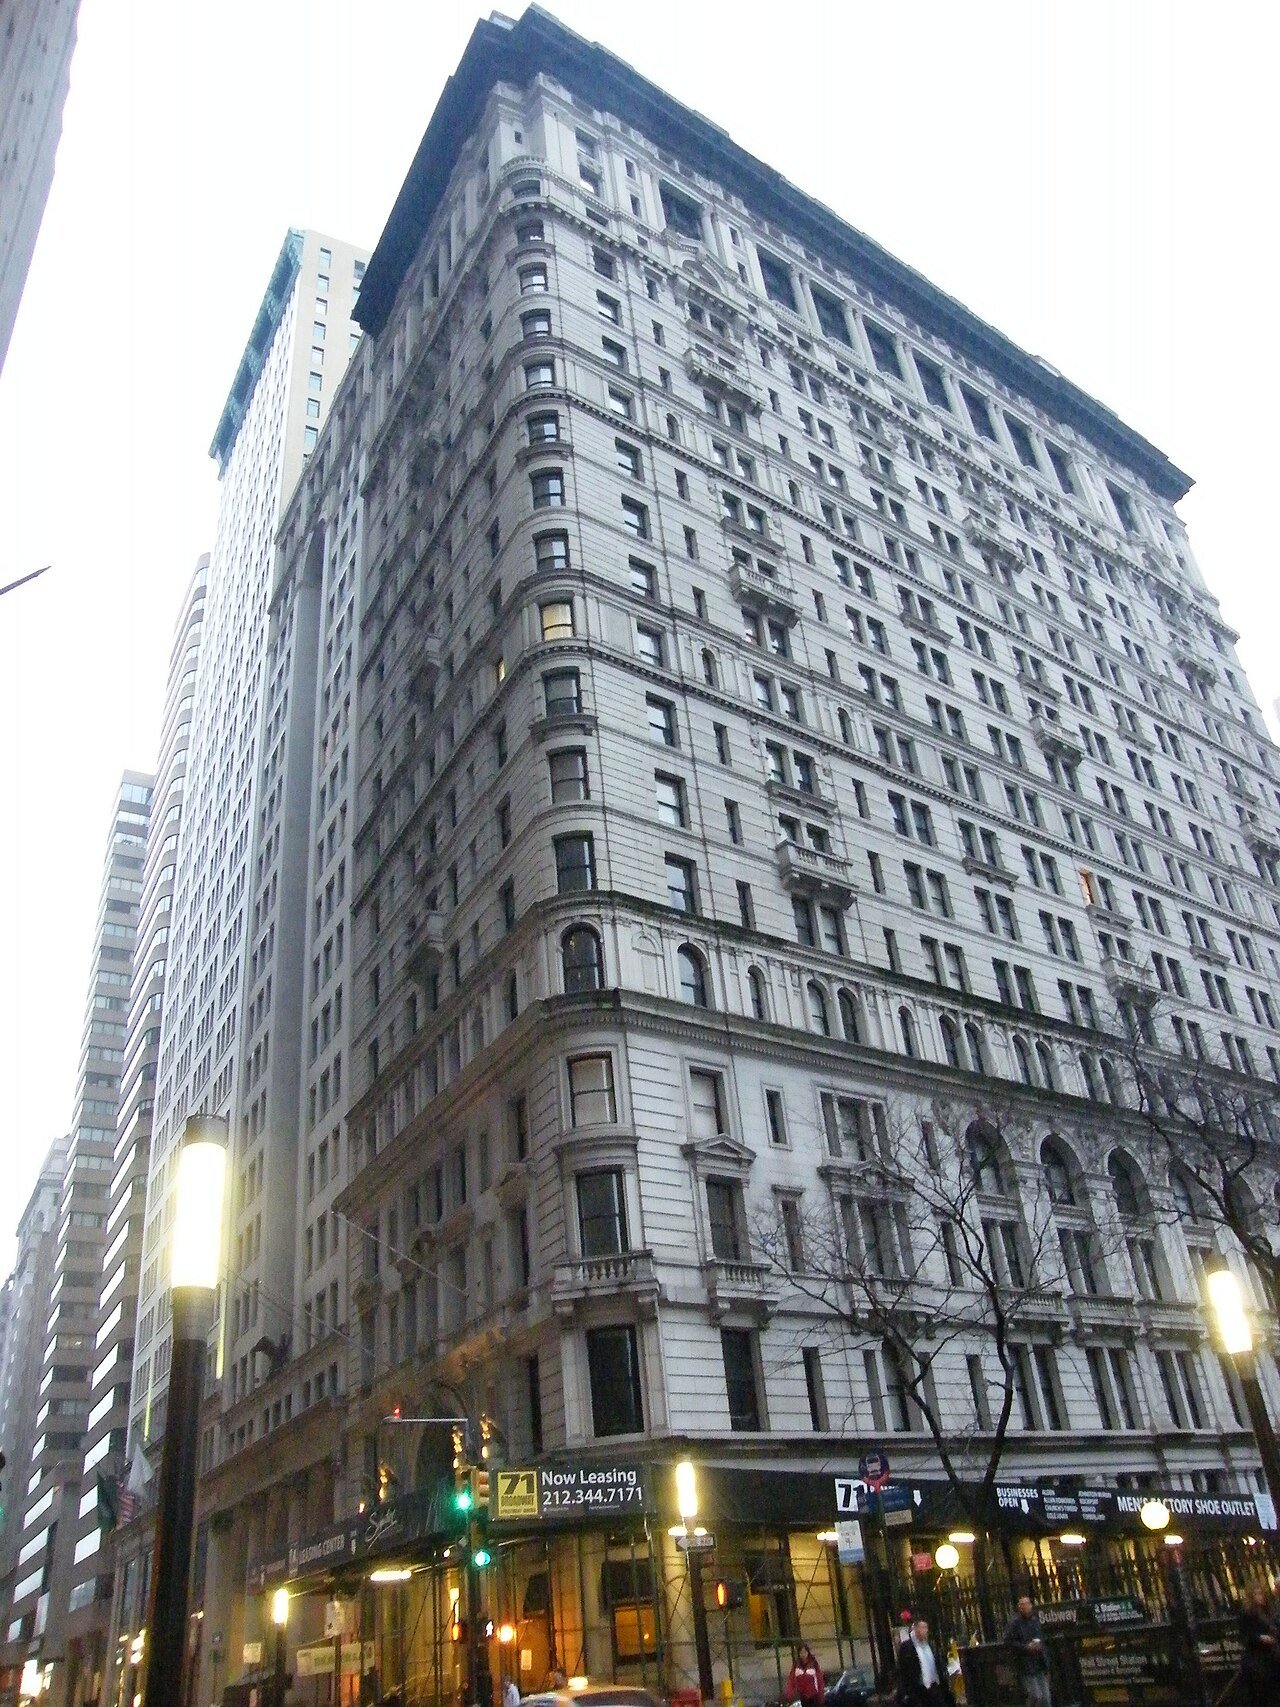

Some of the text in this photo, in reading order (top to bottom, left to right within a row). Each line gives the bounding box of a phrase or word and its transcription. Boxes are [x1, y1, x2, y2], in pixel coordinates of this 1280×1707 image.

[501, 1474, 535, 1495] 71
[541, 1468, 637, 1486] Now Leasing
[542, 1486, 643, 1506] 212.344.7171
[996, 1487, 1039, 1499] BUSINESSES
[998, 1498, 1019, 1508] OPEN
[1196, 1499, 1221, 1515] SHOE
[1221, 1501, 1256, 1516] OUTLET
[1038, 1608, 1077, 1624] Subway
